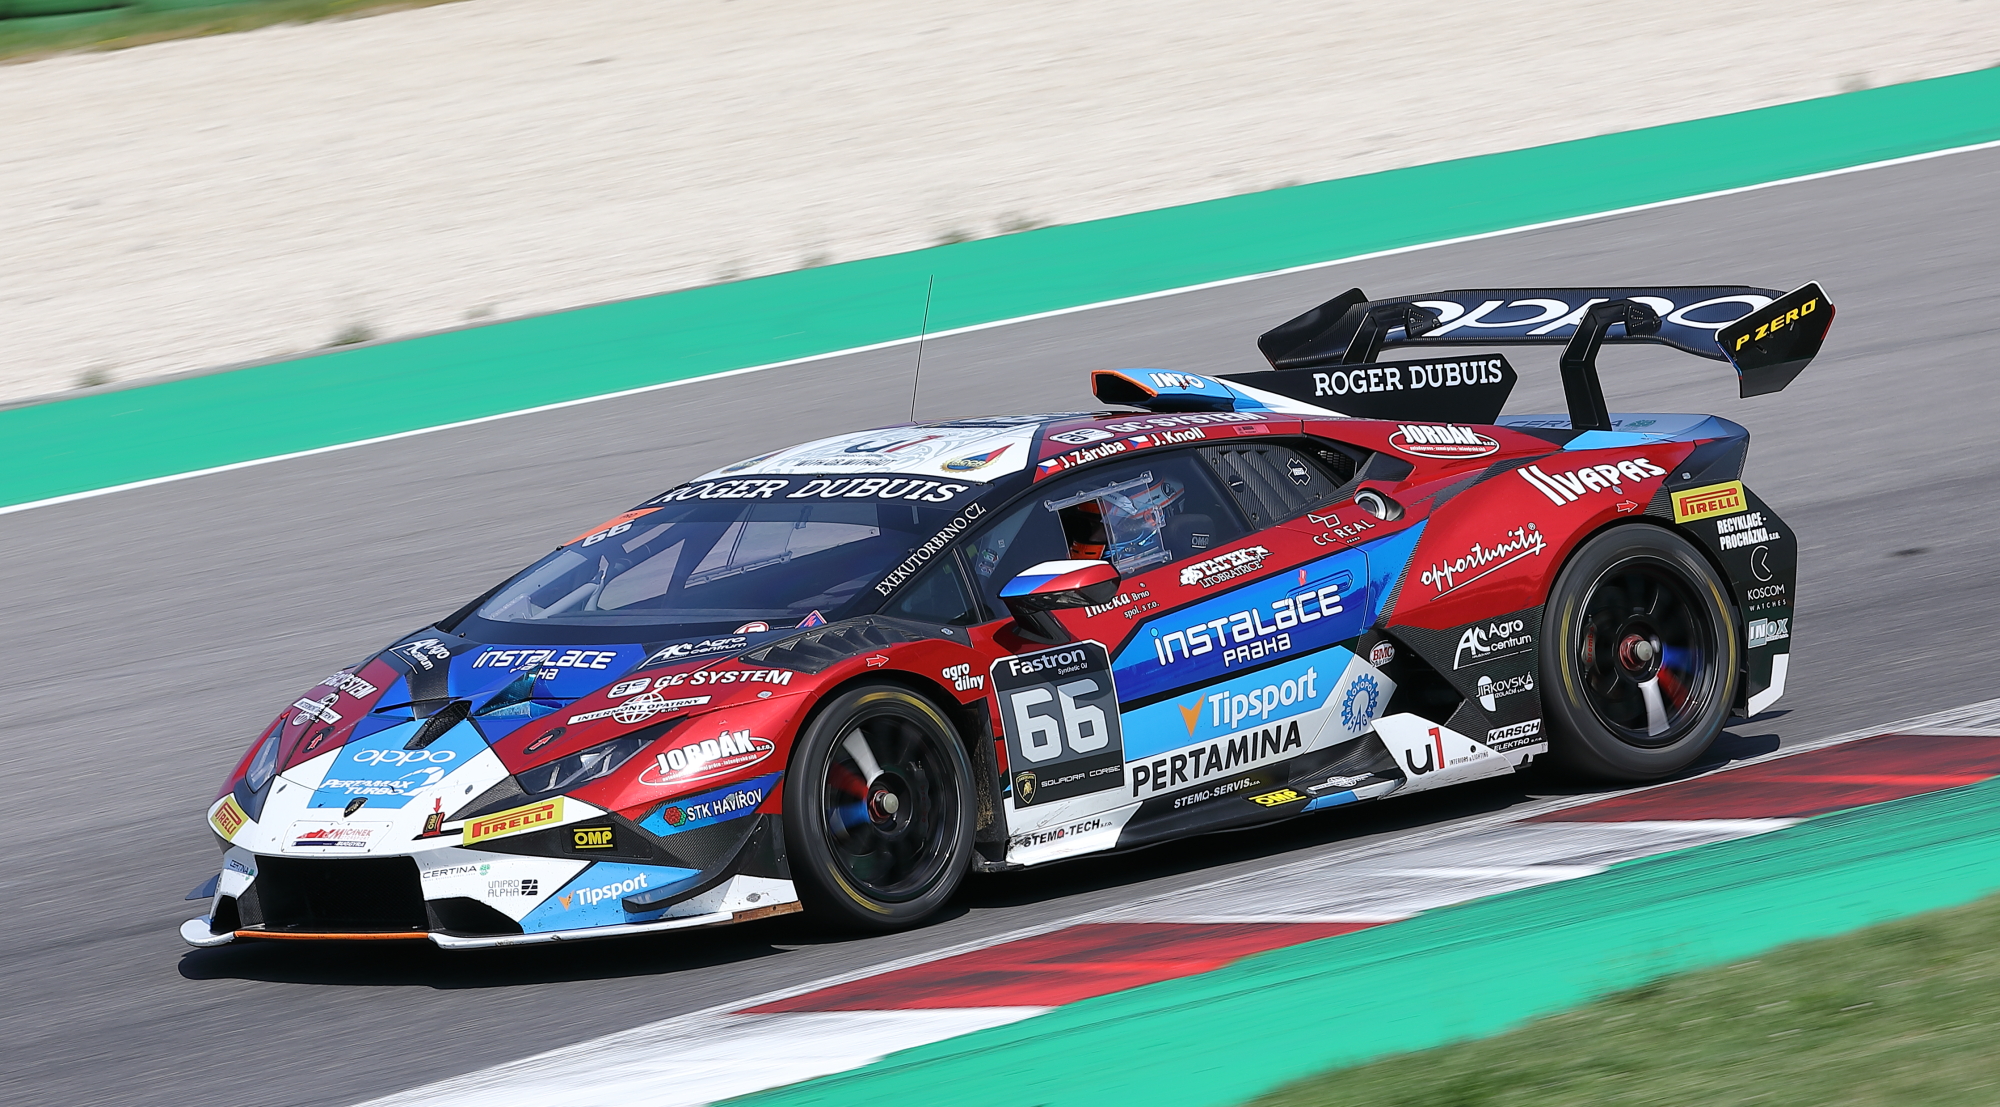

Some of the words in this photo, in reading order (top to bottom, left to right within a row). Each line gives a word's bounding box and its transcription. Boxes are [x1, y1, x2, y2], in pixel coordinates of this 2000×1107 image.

[1735, 334, 1750, 351] P
[1754, 298, 1817, 341] ZERO
[1312, 367, 1404, 396] ROGER
[1408, 359, 1503, 389] DUBUIS
[1104, 421, 1154, 433] GC
[1147, 412, 1268, 428] SYSTEM
[1397, 423, 1483, 445] JORDÁK
[647, 478, 790, 506] ROGER
[786, 478, 969, 503] DUBUIS
[1679, 487, 1740, 517] PIRELLI
[1313, 532, 1337, 546] CC
[1333, 520, 1376, 539] REAL
[1716, 511, 1762, 535] RECYKLACE
[874, 502, 987, 597] EXEKUTORBRNO.CZ
[1719, 527, 1769, 551] PROCHÁZKA
[1198, 560, 1264, 588] LITOBRATRICE
[1131, 590, 1150, 602] Brno
[1747, 584, 1785, 601] KOSCOM
[1123, 605, 1142, 620] spol.
[1142, 604, 1147, 612] s
[1147, 601, 1160, 610] r.o.
[1749, 599, 1787, 612] WATCHES
[1489, 619, 1524, 638] Agro
[691, 642, 747, 655] centrum
[694, 636, 747, 649] Agro
[1490, 635, 1532, 652] centrum
[1009, 648, 1086, 677] Fastron
[1373, 646, 1393, 661] BMC
[690, 669, 794, 686] SYSTEM
[942, 662, 970, 681] agro
[1058, 664, 1080, 676] Synthetic
[954, 675, 985, 691] dílny
[1475, 671, 1534, 698] JIRKOVSKÁ
[1208, 665, 1318, 730] Tipsport
[577, 705, 643, 722] INTERMONT
[646, 698, 701, 711] OPATRNY
[1011, 678, 1109, 763] 66
[1488, 721, 1541, 743] KARSCH
[656, 729, 756, 775] JORDÁK
[1493, 737, 1530, 751] ELEKTRO
[353, 749, 458, 767] oppo
[1132, 720, 1302, 798] PERTAMINA
[1041, 772, 1086, 788] SQUADRA
[1089, 765, 1121, 778] CORSE
[344, 786, 405, 796] TURBO
[1255, 790, 1298, 805] OMP
[214, 801, 243, 835] PIRELLI
[471, 804, 555, 839] PIRELLI
[686, 802, 711, 821] STK
[574, 831, 613, 845] OMP
[422, 865, 477, 879] CERTINA
[487, 879, 520, 888] UNIPRO
[487, 888, 520, 897] ALPHA
[576, 872, 648, 905] Tipsport
